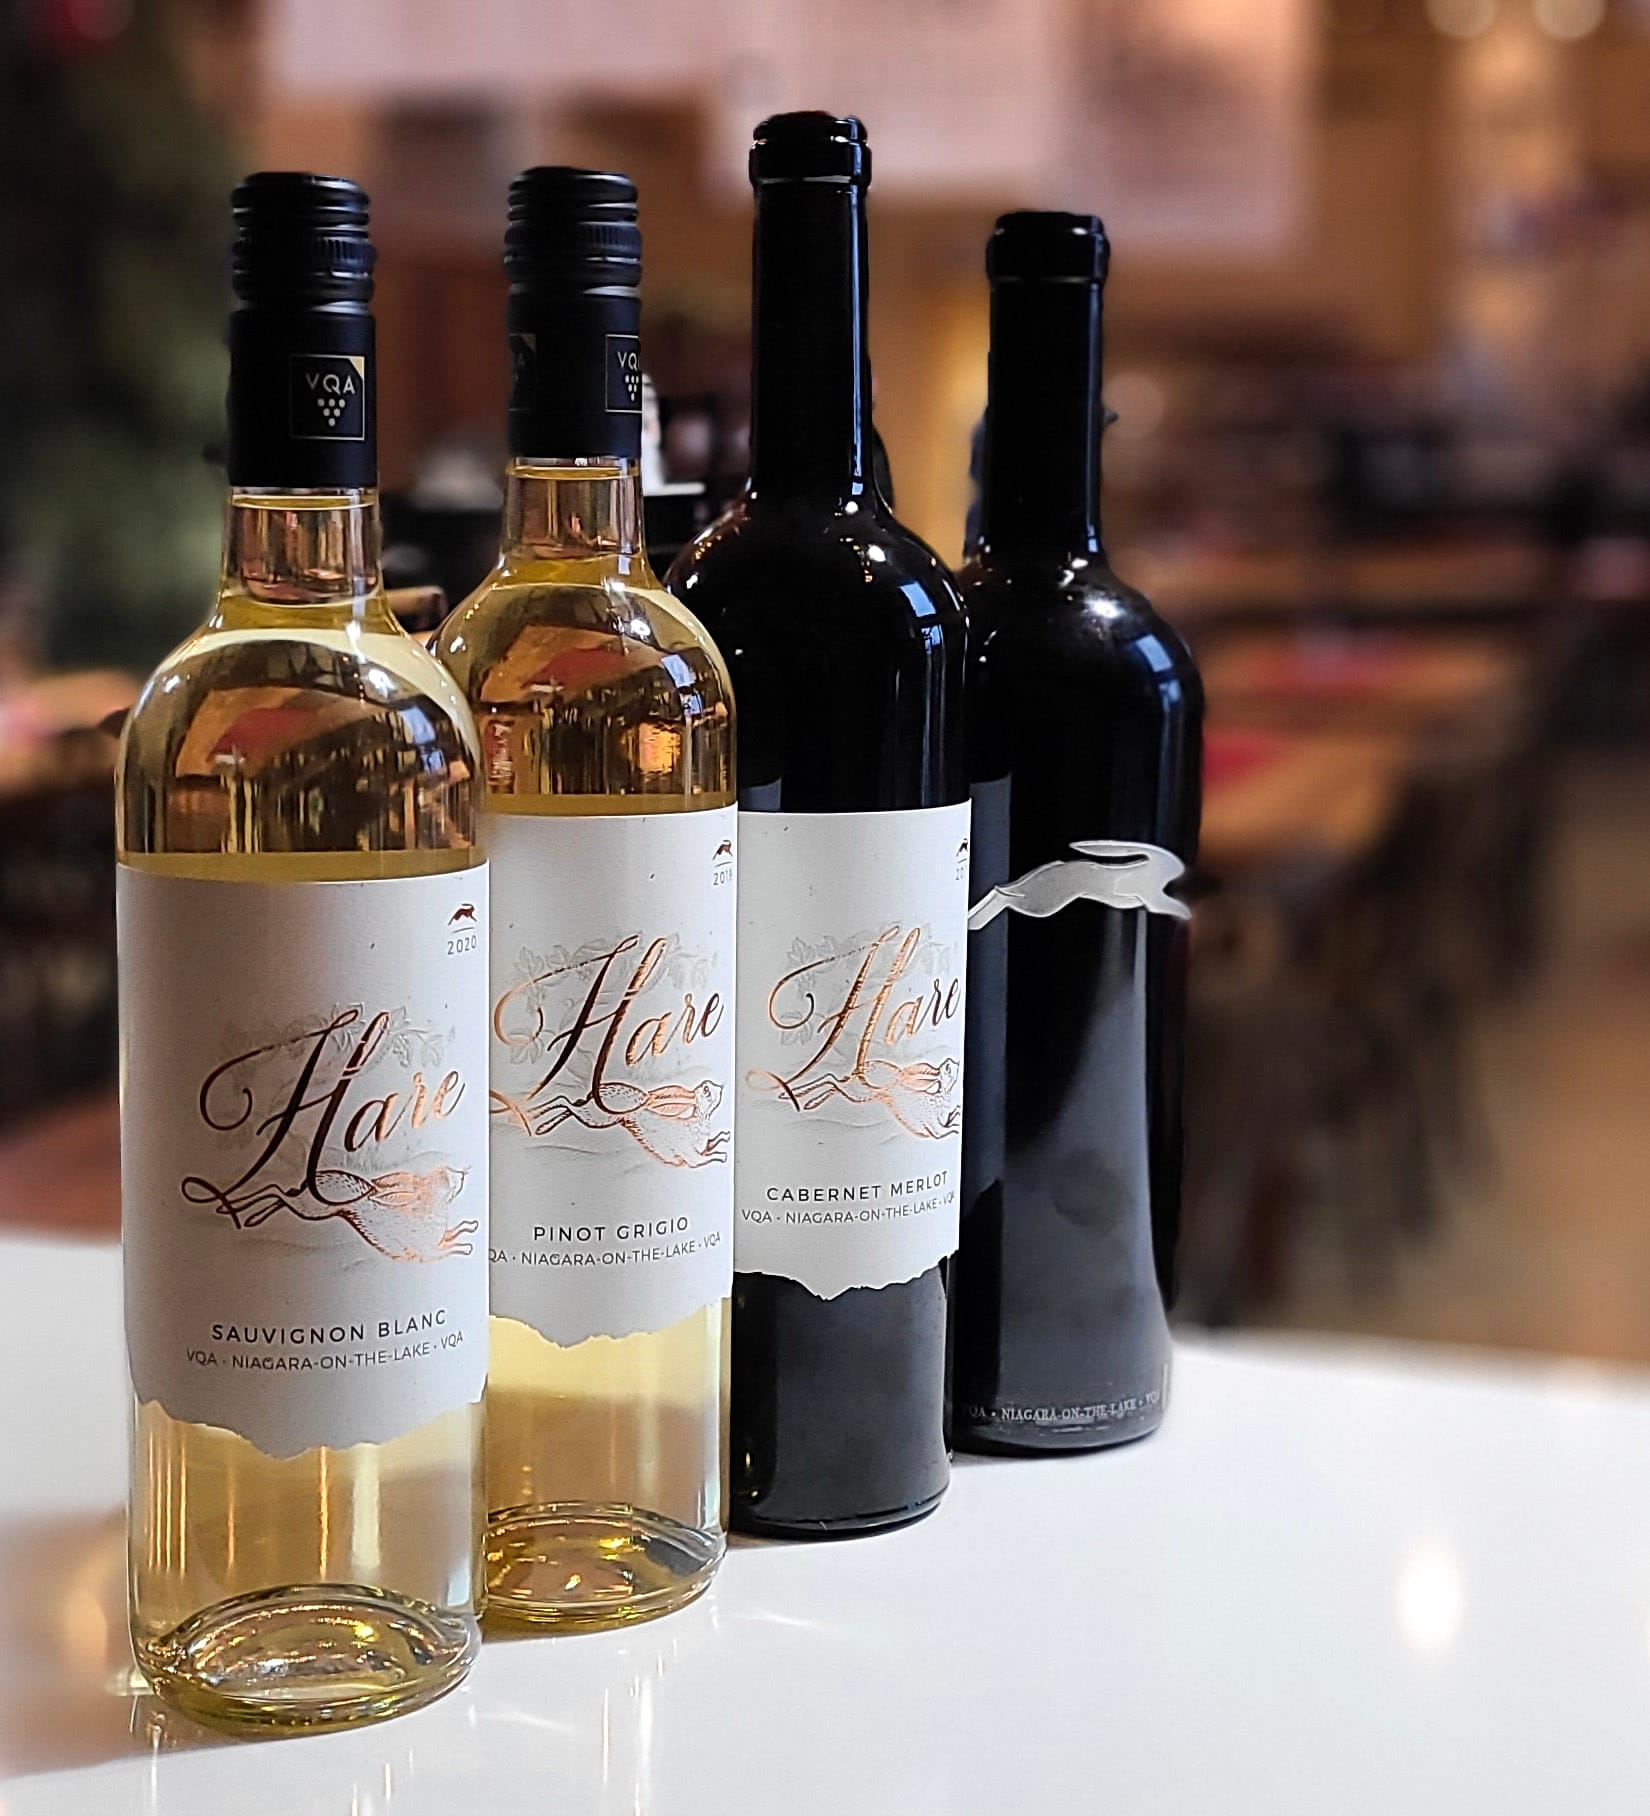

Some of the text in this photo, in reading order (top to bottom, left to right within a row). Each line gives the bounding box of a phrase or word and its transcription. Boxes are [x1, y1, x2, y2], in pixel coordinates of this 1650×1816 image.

[617, 350, 640, 371] VQ
[305, 373, 356, 396] VQA
[447, 934, 477, 955] 2020
[746, 924, 961, 1112] Hare
[490, 934, 724, 1137] Hare
[182, 1009, 466, 1229] Hare
[766, 1170, 949, 1202] CABERNET MERLOT
[741, 1208, 773, 1224] VQA
[785, 1197, 938, 1225] NIAGARA-ON-THE-LAKE
[533, 1216, 689, 1242] PINOT GRIGIO
[488, 1230, 722, 1266] QA NIAGARA-ON-THE-LAKE VQA
[211, 1309, 447, 1345] SAUVIGNON BLANC
[185, 1330, 464, 1371] VQA NIAGARA-ON-THE-LAKE VQA
